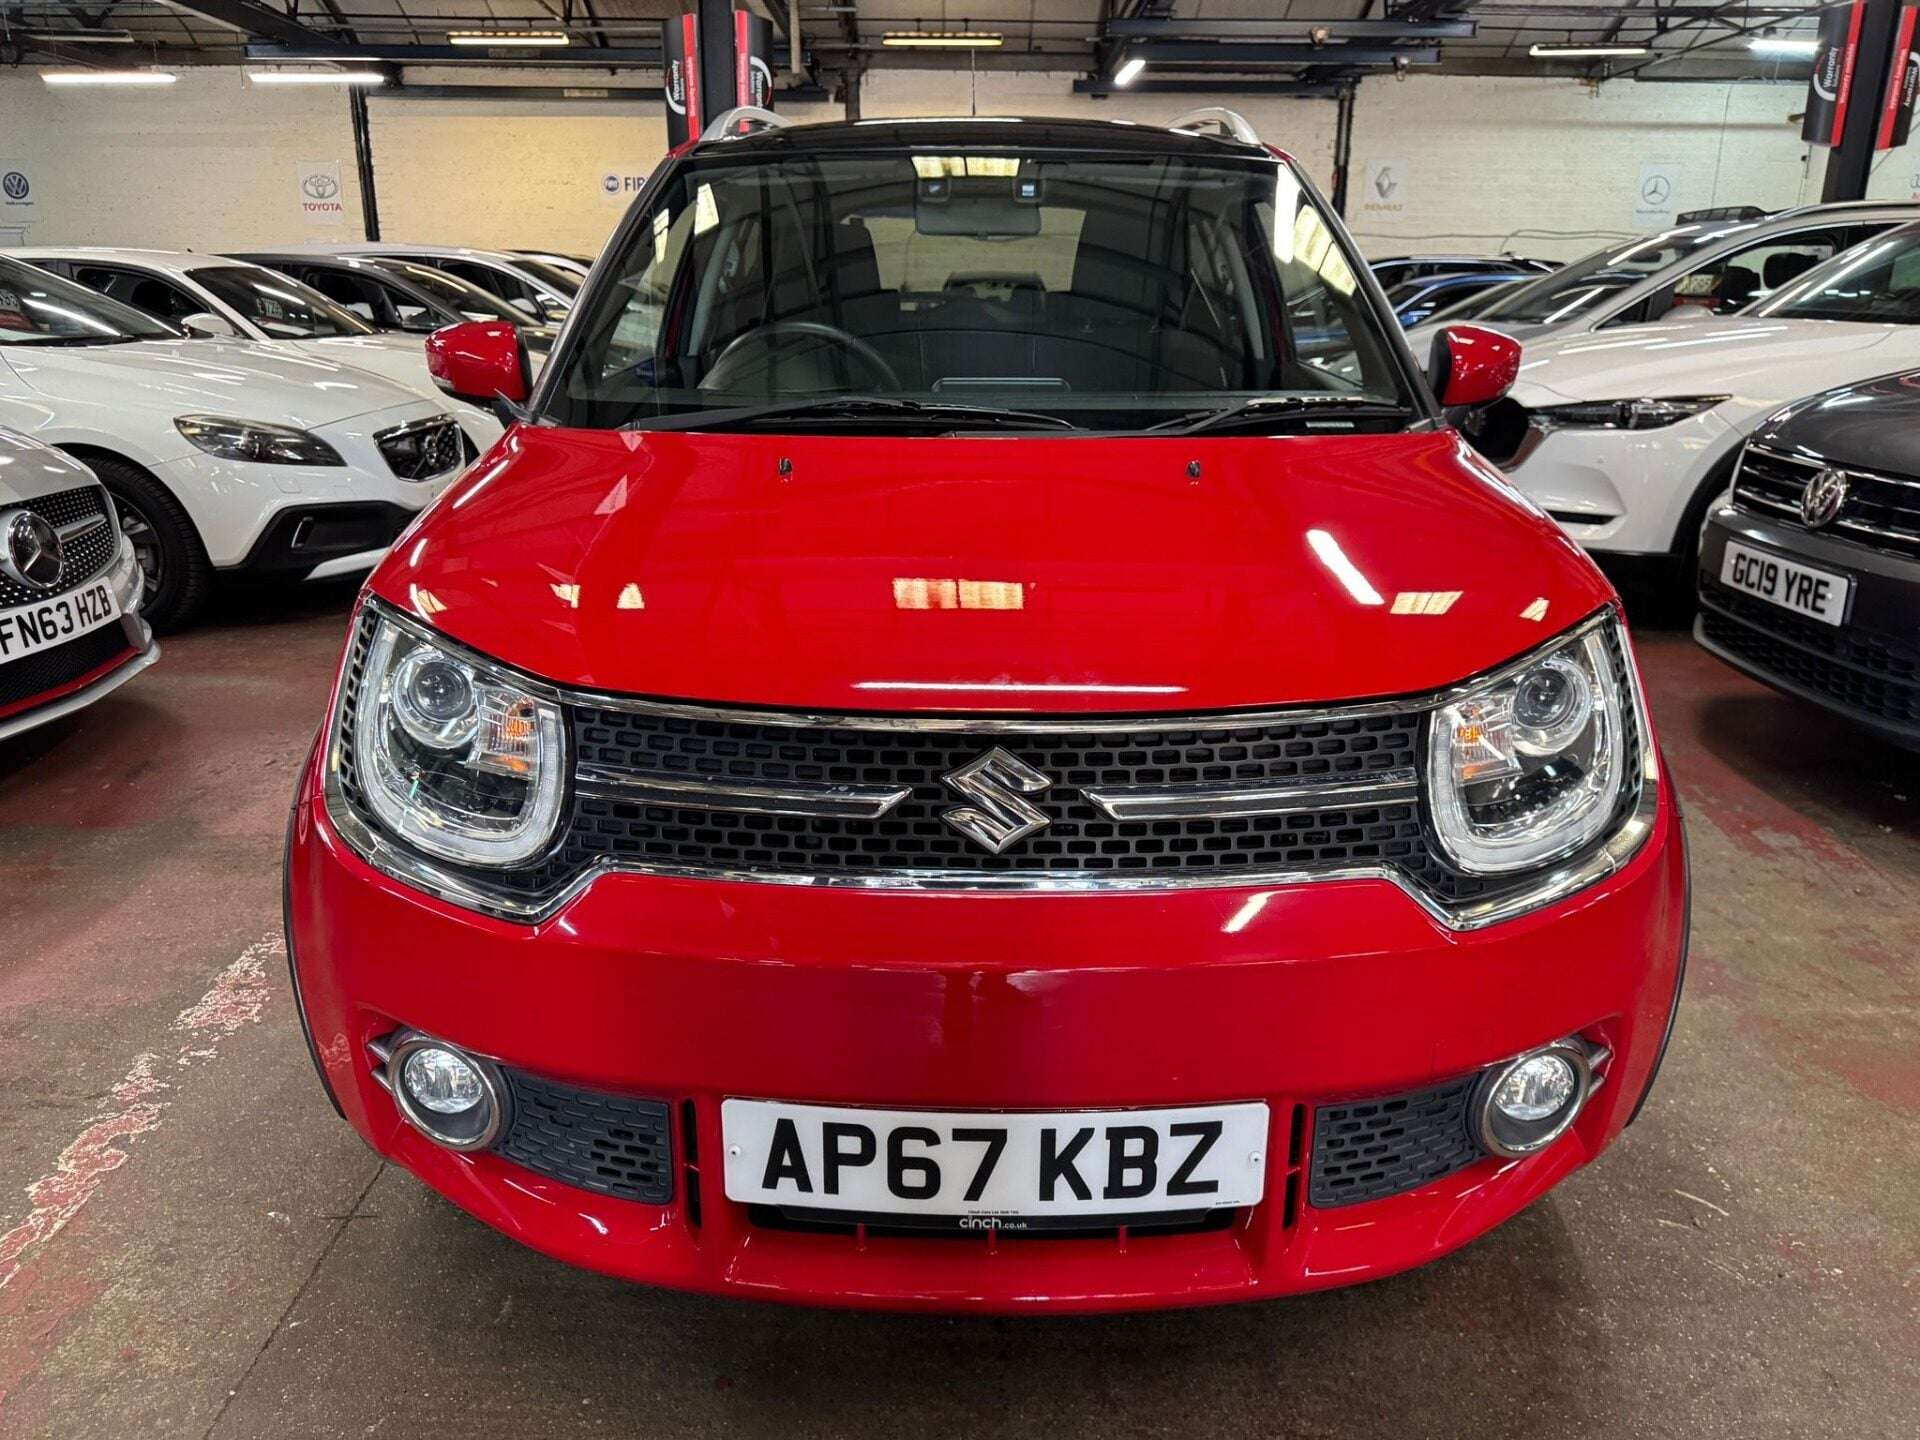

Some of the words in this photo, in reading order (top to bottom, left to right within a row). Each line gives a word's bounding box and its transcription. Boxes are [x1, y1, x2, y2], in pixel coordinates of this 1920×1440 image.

[672, 60, 681, 101] Warranty
[1824, 47, 1839, 88] Warranty
[1903, 66, 1919, 108] Warranty
[302, 202, 343, 211] TOYOTA
[1732, 552, 1778, 595] GC19
[1784, 569, 1830, 614] YRE
[0, 601, 74, 655] FN63
[75, 585, 112, 628] HZB
[761, 1117, 1008, 1202] AP67
[1038, 1120, 1223, 1202] KBZ
